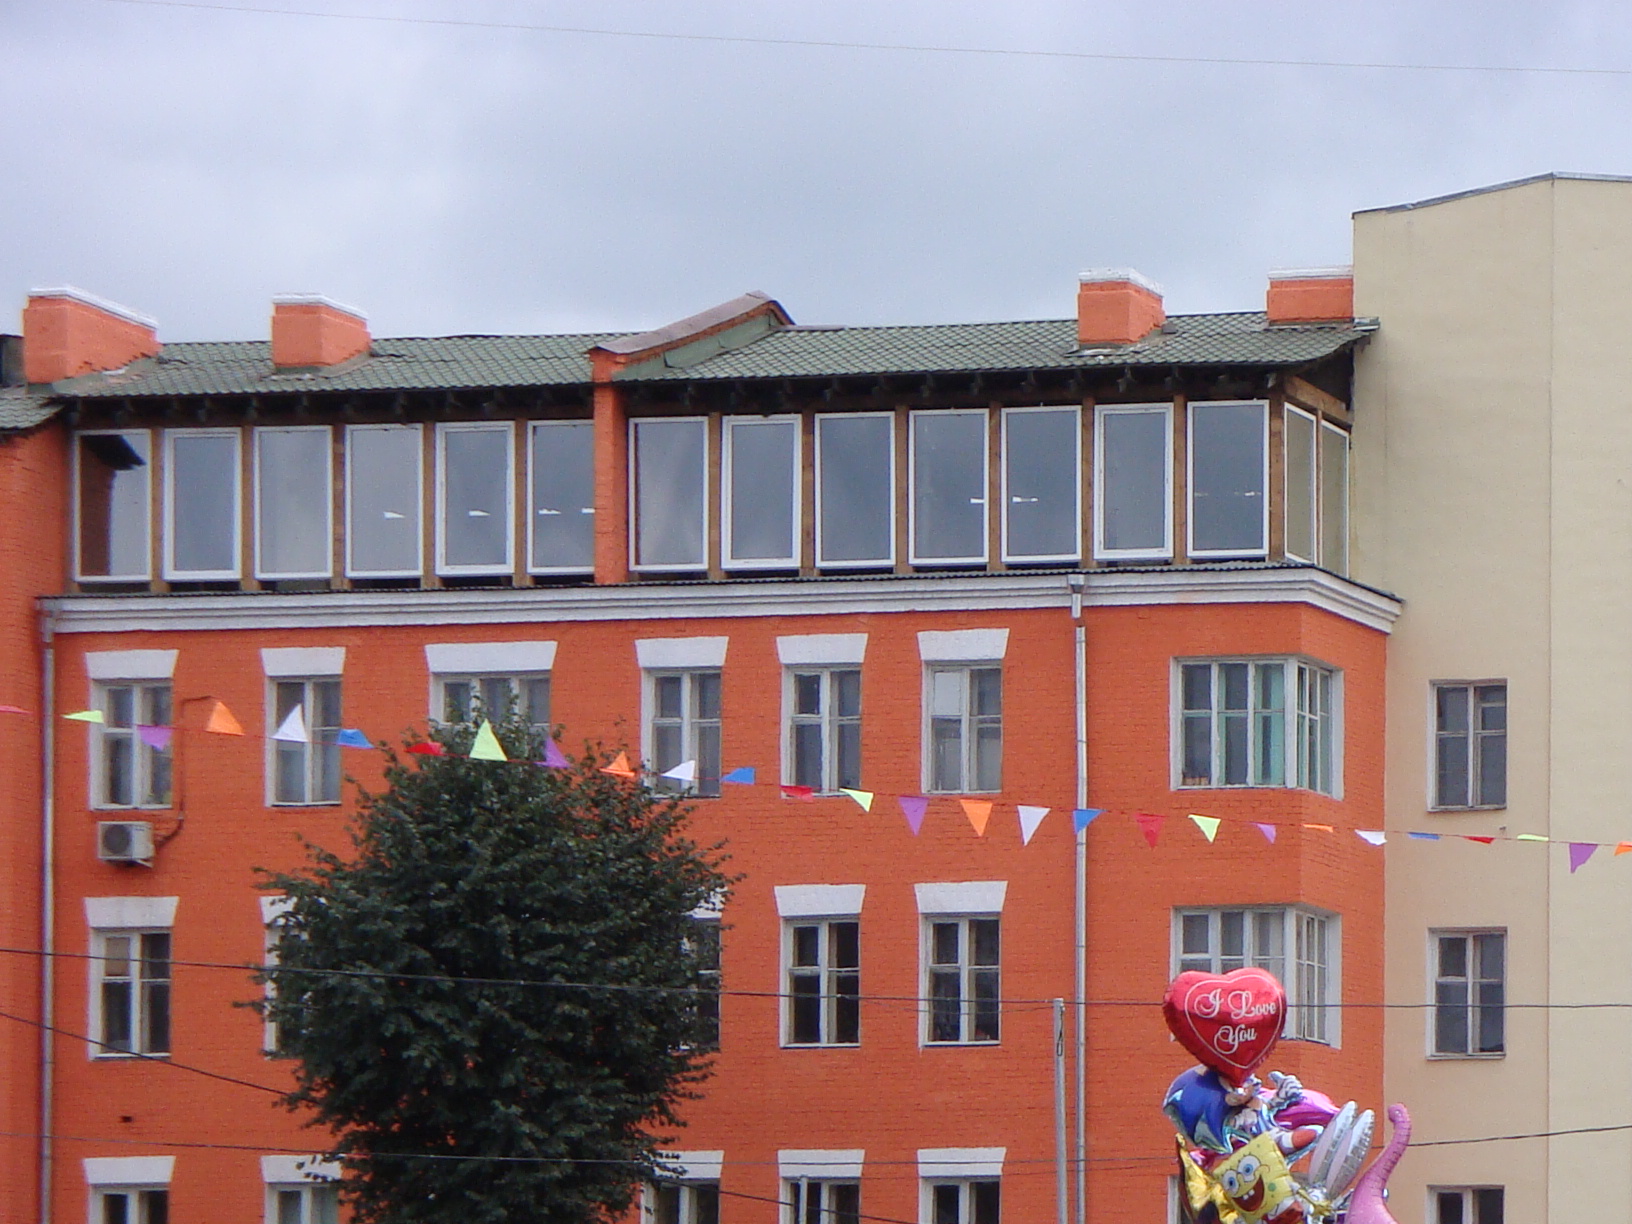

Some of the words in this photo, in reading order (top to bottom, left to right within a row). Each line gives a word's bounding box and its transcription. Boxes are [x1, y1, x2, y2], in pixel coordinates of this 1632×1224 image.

[1194, 988, 1224, 1018] I
[1228, 990, 1276, 1020] Love
[1214, 1024, 1257, 1055] You
